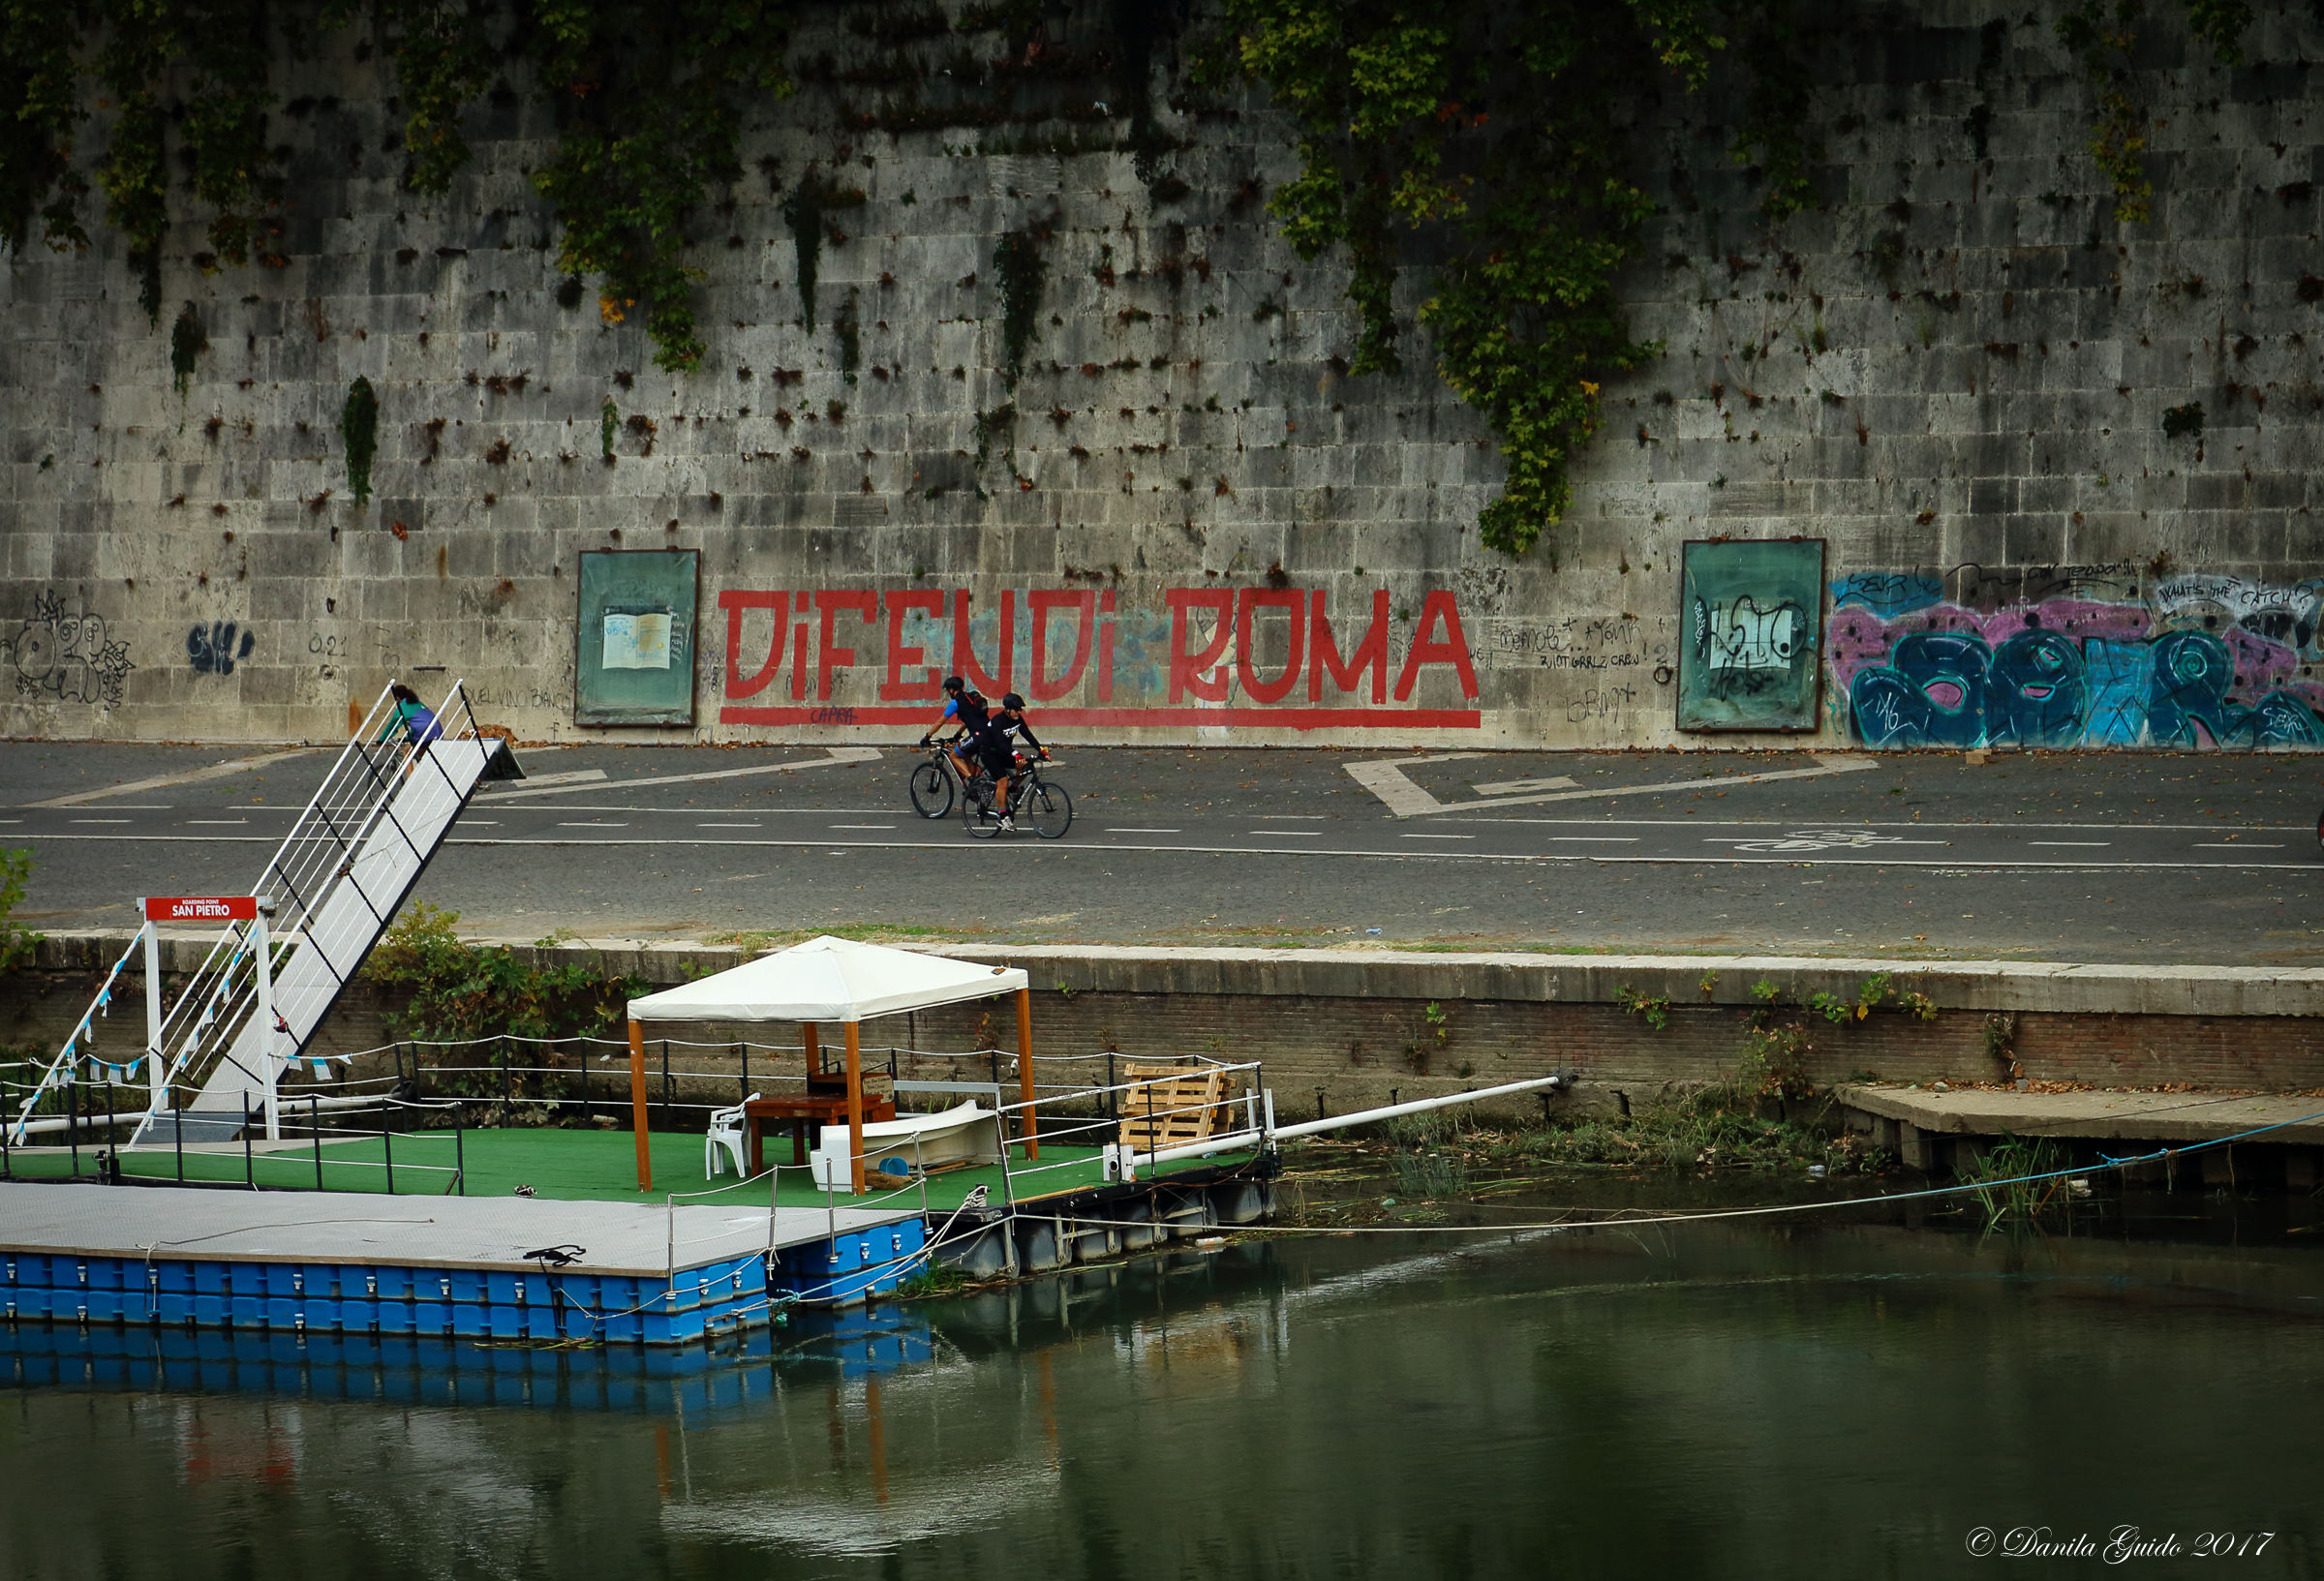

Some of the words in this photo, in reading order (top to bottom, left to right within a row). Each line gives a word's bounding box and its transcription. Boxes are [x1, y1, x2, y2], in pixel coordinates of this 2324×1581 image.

[2158, 584, 2204, 604] WHAT'S
[2211, 585, 2232, 598] THE
[1165, 588, 1480, 705] ROMA
[171, 904, 194, 917] SAN
[196, 904, 230, 917] PIETRO
